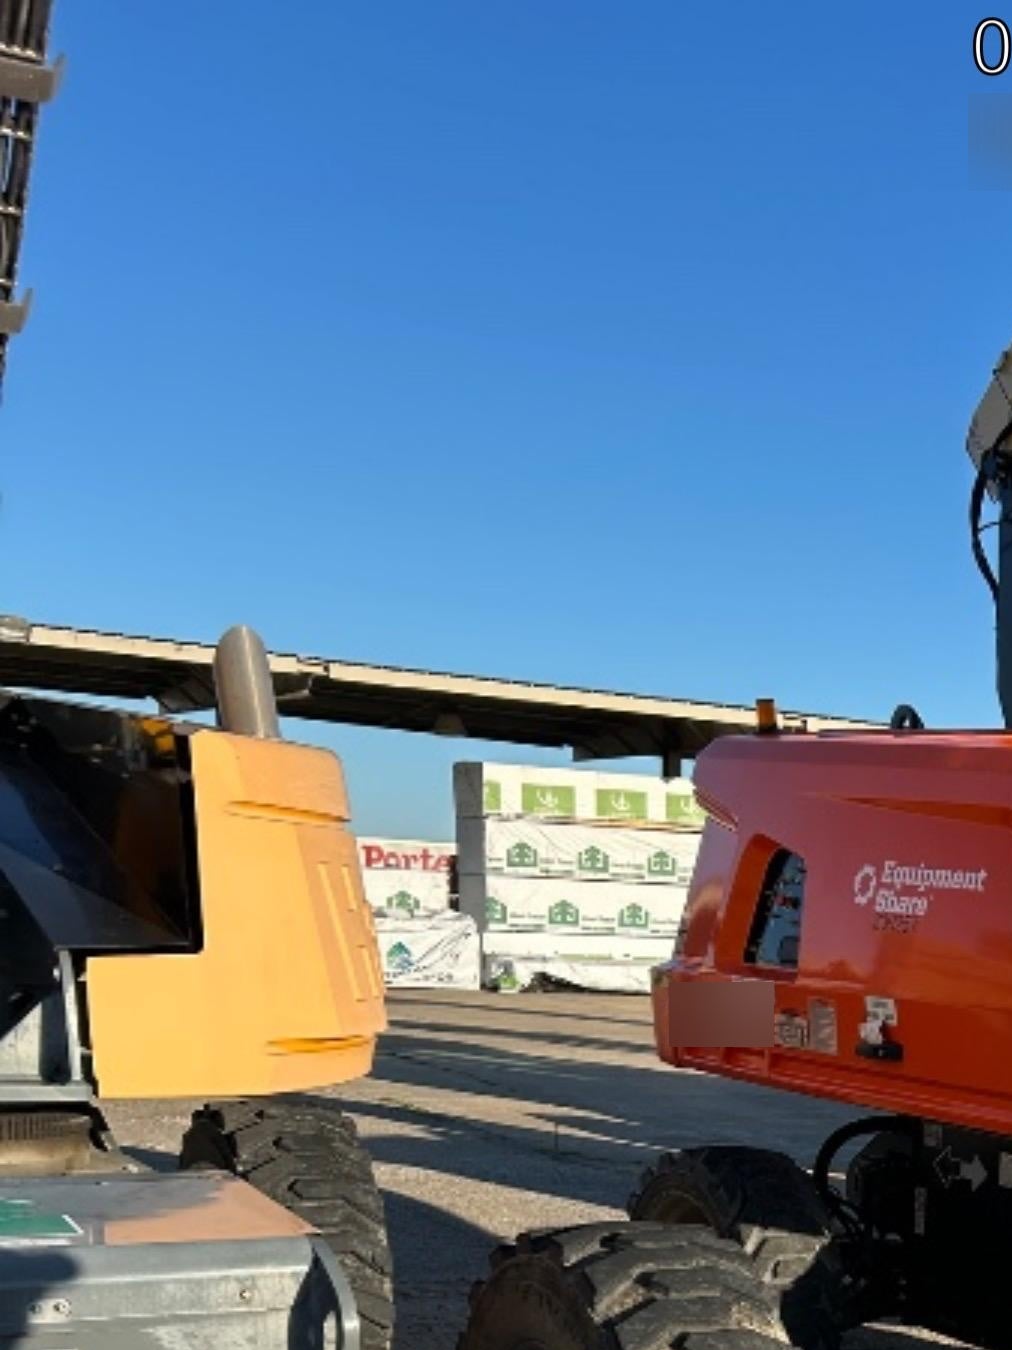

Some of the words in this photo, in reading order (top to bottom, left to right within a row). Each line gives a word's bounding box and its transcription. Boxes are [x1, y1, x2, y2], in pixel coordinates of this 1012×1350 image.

[361, 844, 455, 872] Porte
[881, 859, 988, 892] Equipment
[875, 888, 928, 916] Share
